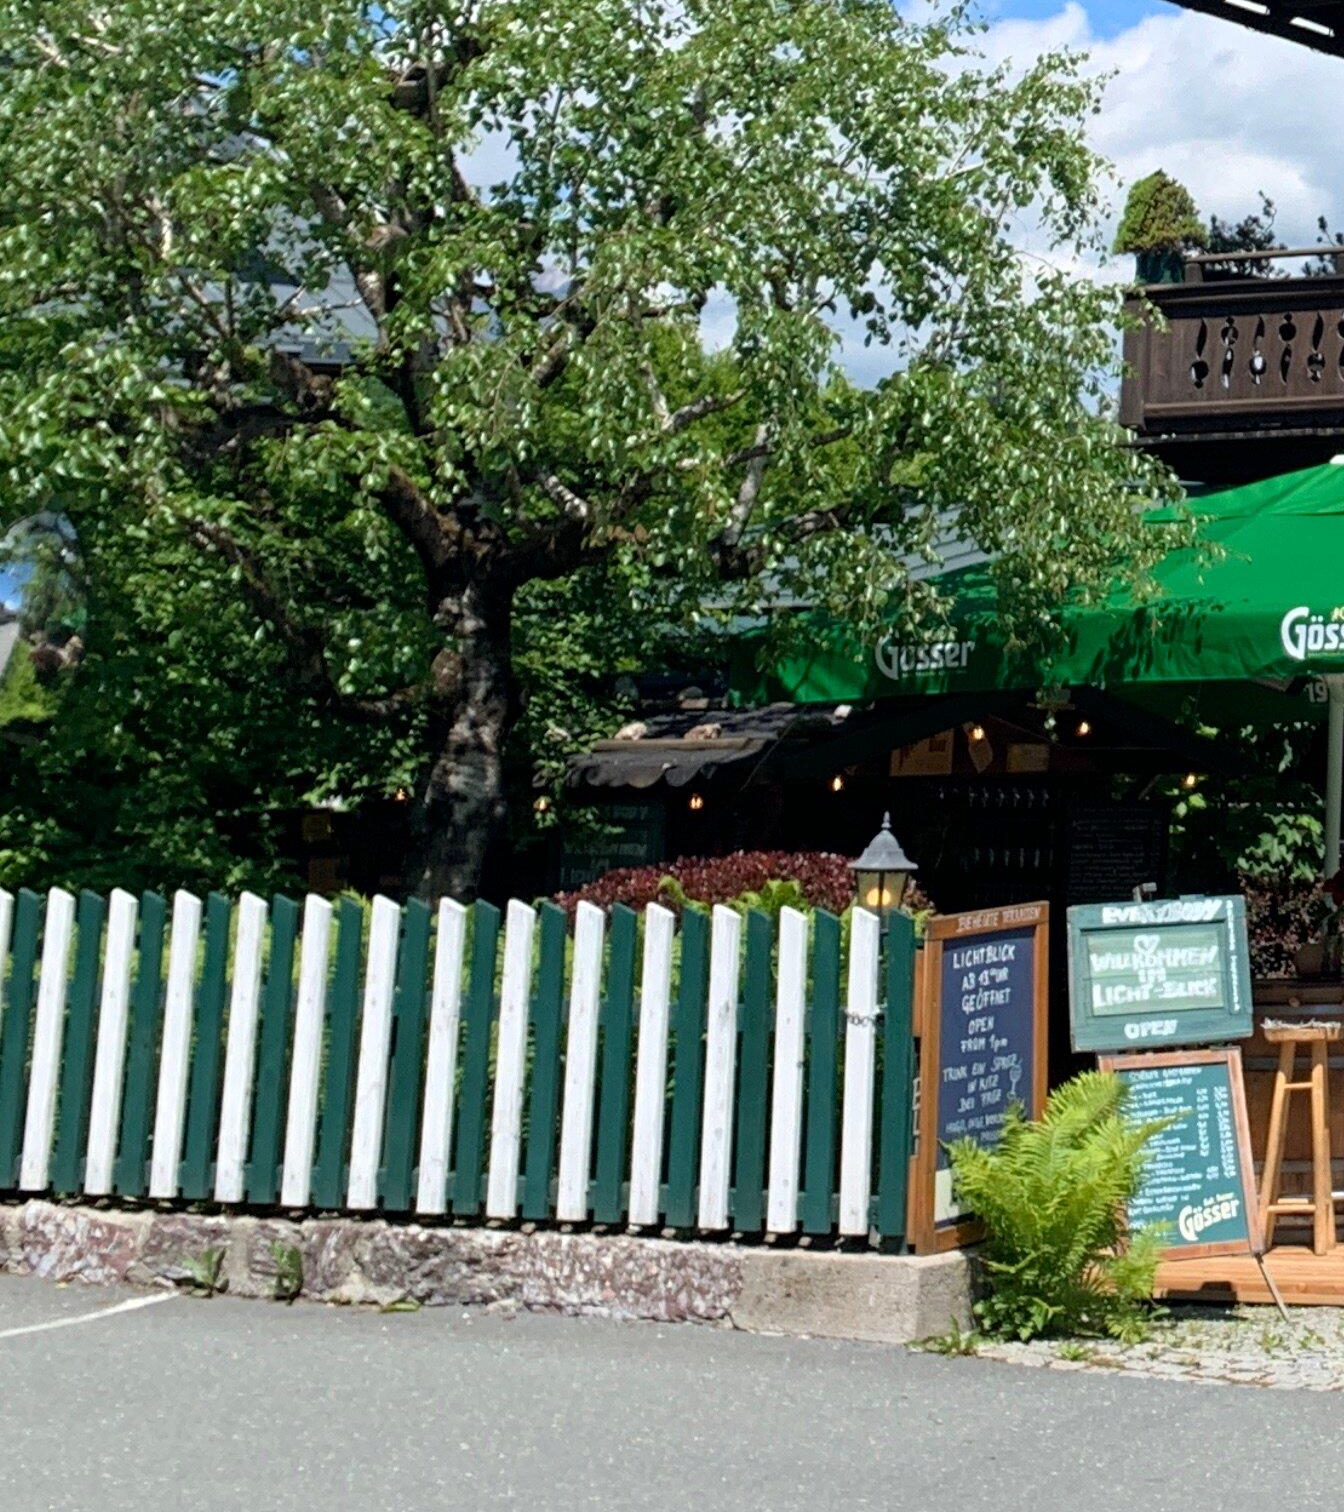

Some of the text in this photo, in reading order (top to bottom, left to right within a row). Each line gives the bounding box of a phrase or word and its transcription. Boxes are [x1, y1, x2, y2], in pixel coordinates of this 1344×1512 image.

[1102, 899, 1222, 924] EVERYBODY
[952, 944, 1016, 969] LICHTBLICK
[1090, 945, 1218, 971] WILLKOMMEN
[961, 987, 1011, 1014] GEÖFFNET
[968, 1016, 995, 1035] OPEN
[1124, 1019, 1178, 1039] OPEN
[960, 1037, 986, 1053] FROM
[1179, 1199, 1239, 1241] Gösser
